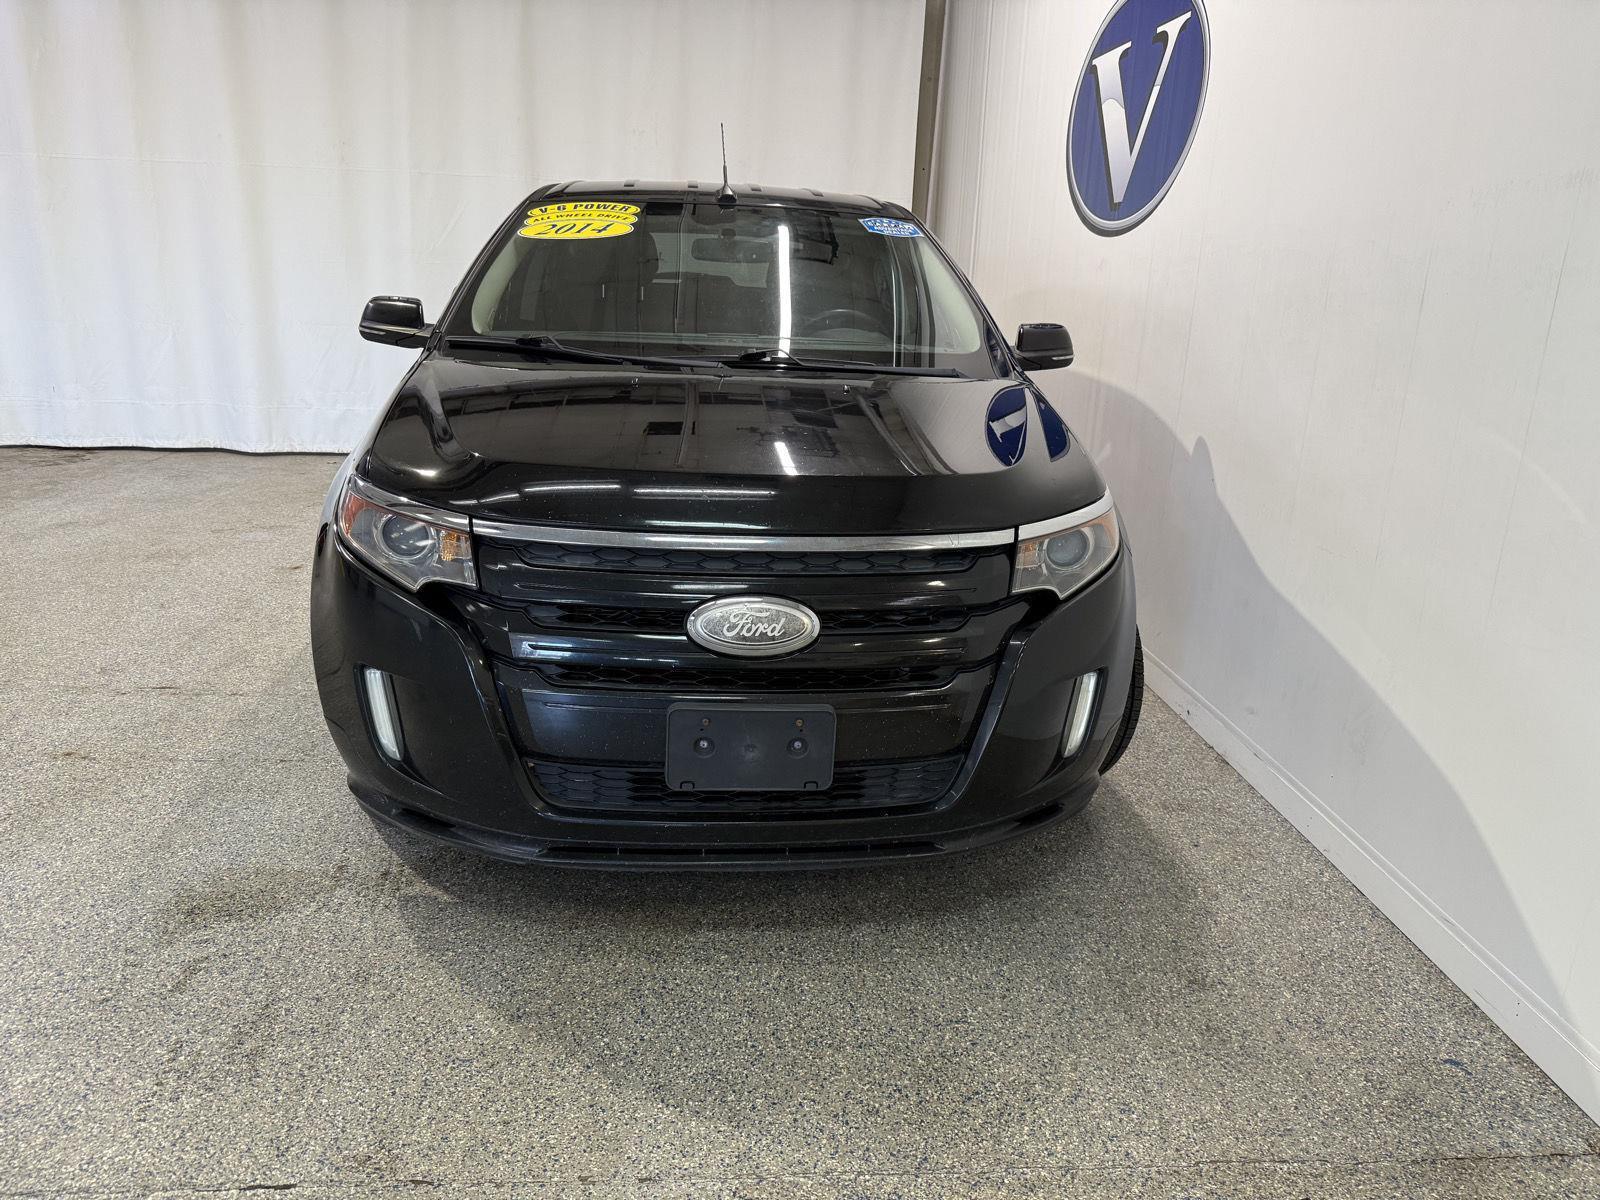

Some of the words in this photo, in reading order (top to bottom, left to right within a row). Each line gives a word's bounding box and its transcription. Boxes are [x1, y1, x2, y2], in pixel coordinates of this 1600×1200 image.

[1092, 11, 1192, 203] V
[538, 204, 567, 213] V-6
[573, 203, 632, 212] POWER
[533, 215, 552, 223] ALL
[597, 213, 632, 221] DRIVE
[534, 223, 615, 235] 2014
[723, 610, 786, 637] Ford
